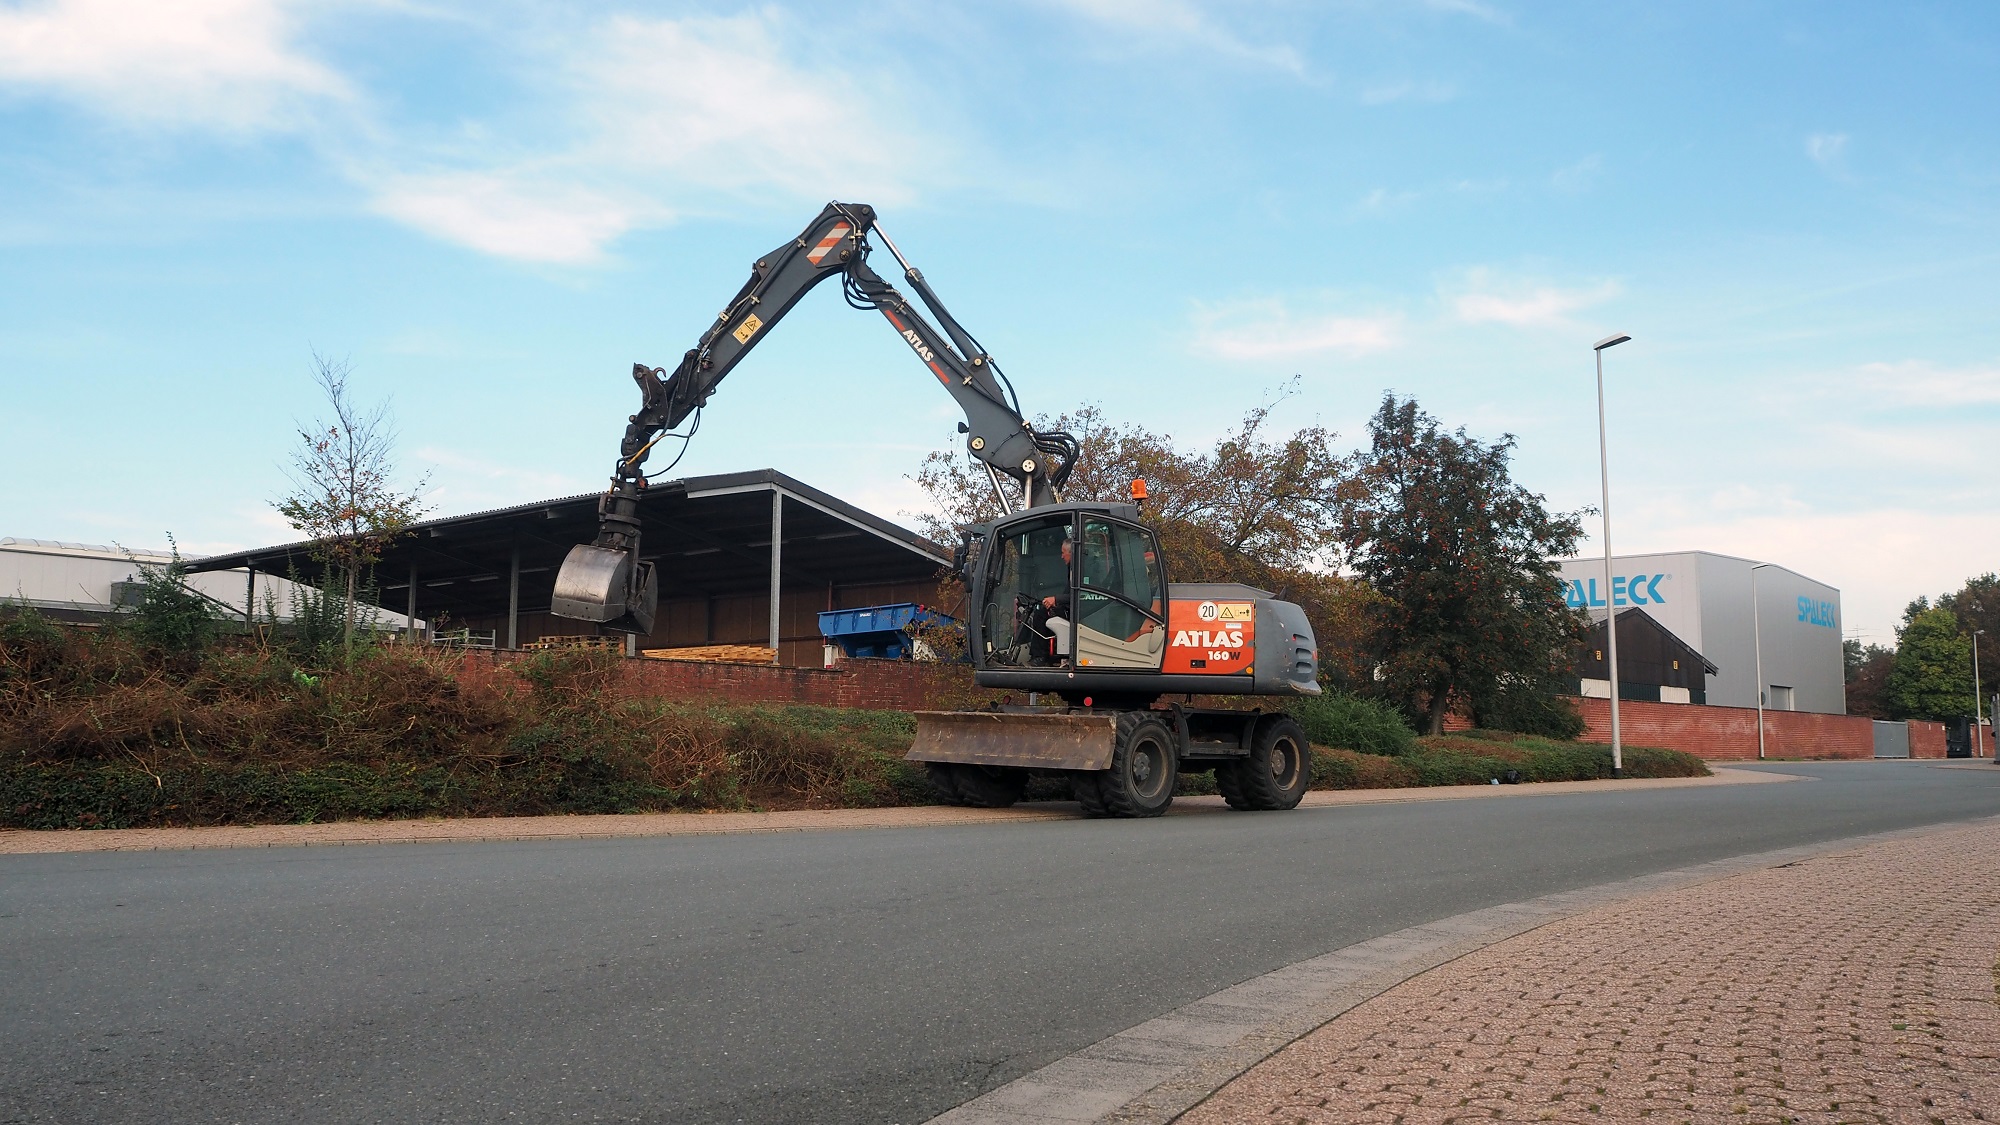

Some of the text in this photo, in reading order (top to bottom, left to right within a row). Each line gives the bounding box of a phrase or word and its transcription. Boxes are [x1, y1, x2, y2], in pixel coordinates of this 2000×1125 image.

[903, 329, 934, 362] ATLAS
[1558, 574, 1666, 608] ALECK
[1202, 605, 1214, 618] 20
[1171, 630, 1244, 648] ATLAS
[1207, 650, 1241, 661] 160W
